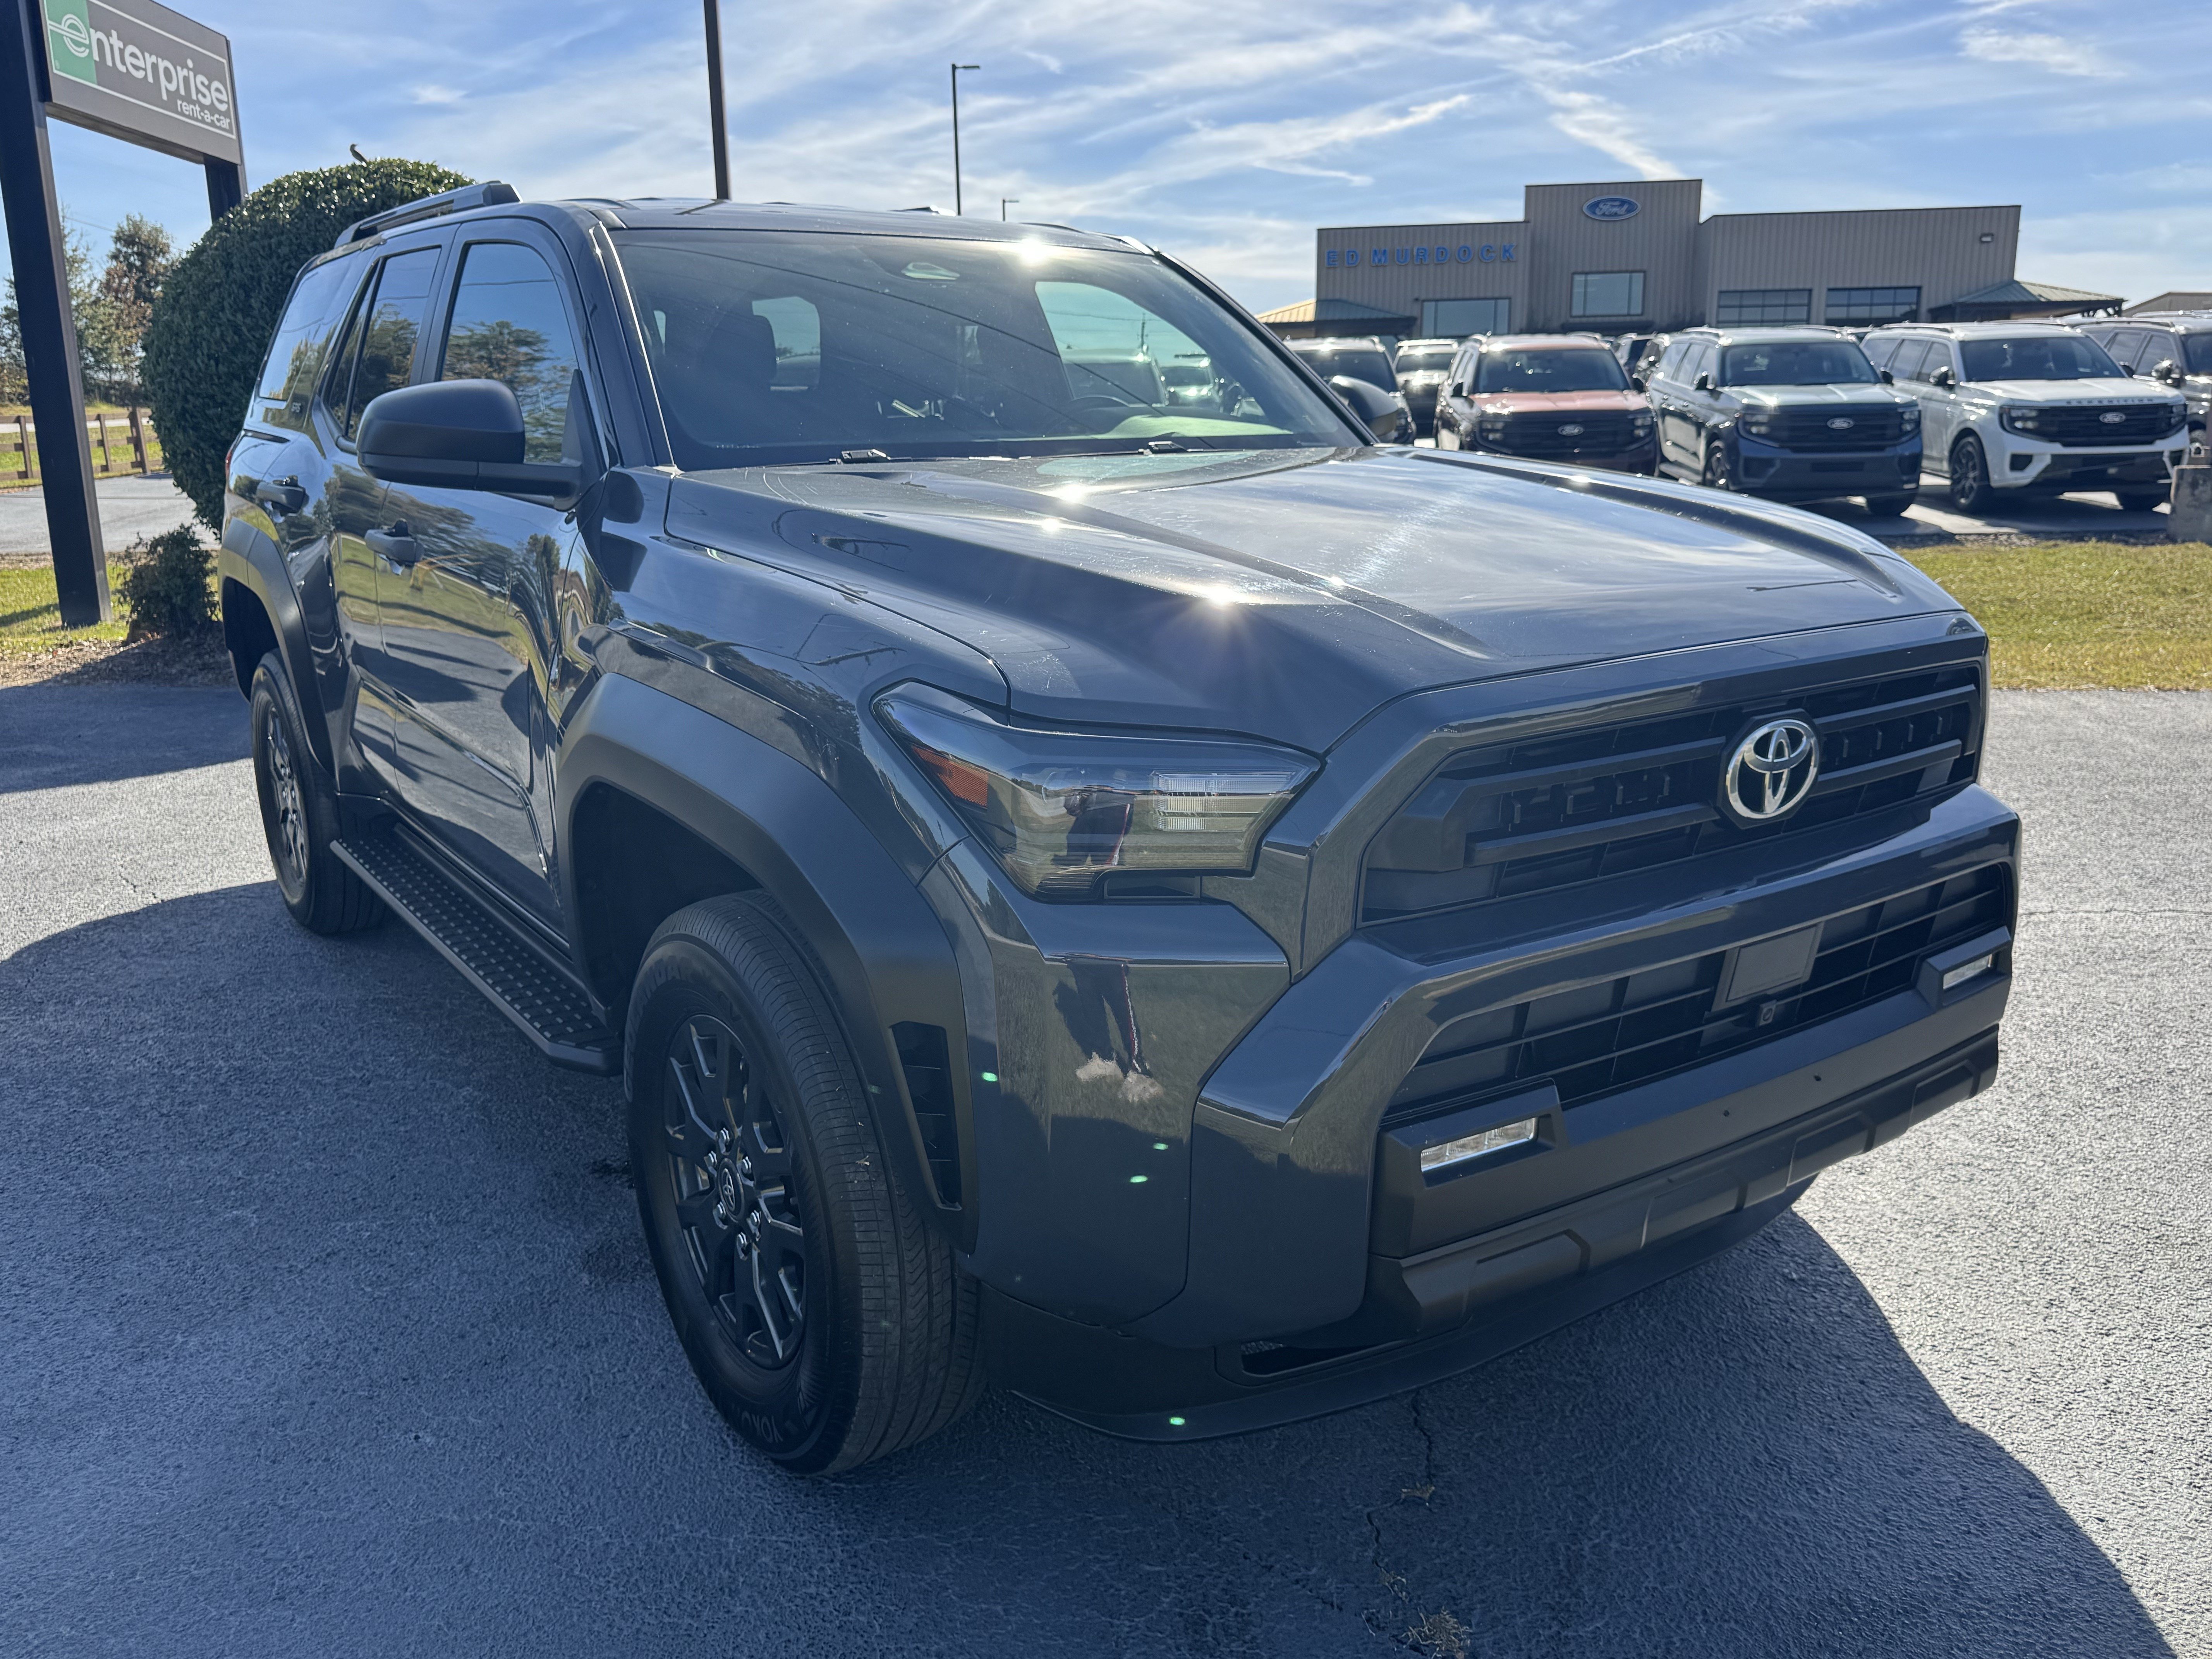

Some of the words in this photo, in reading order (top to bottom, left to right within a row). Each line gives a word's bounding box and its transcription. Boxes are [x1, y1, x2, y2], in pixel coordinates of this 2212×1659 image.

[49, 14, 228, 112] enterprise
[177, 99, 230, 130] rent-a-car
[1325, 249, 1360, 268] ED
[1371, 242, 1517, 266] MURDOCK
